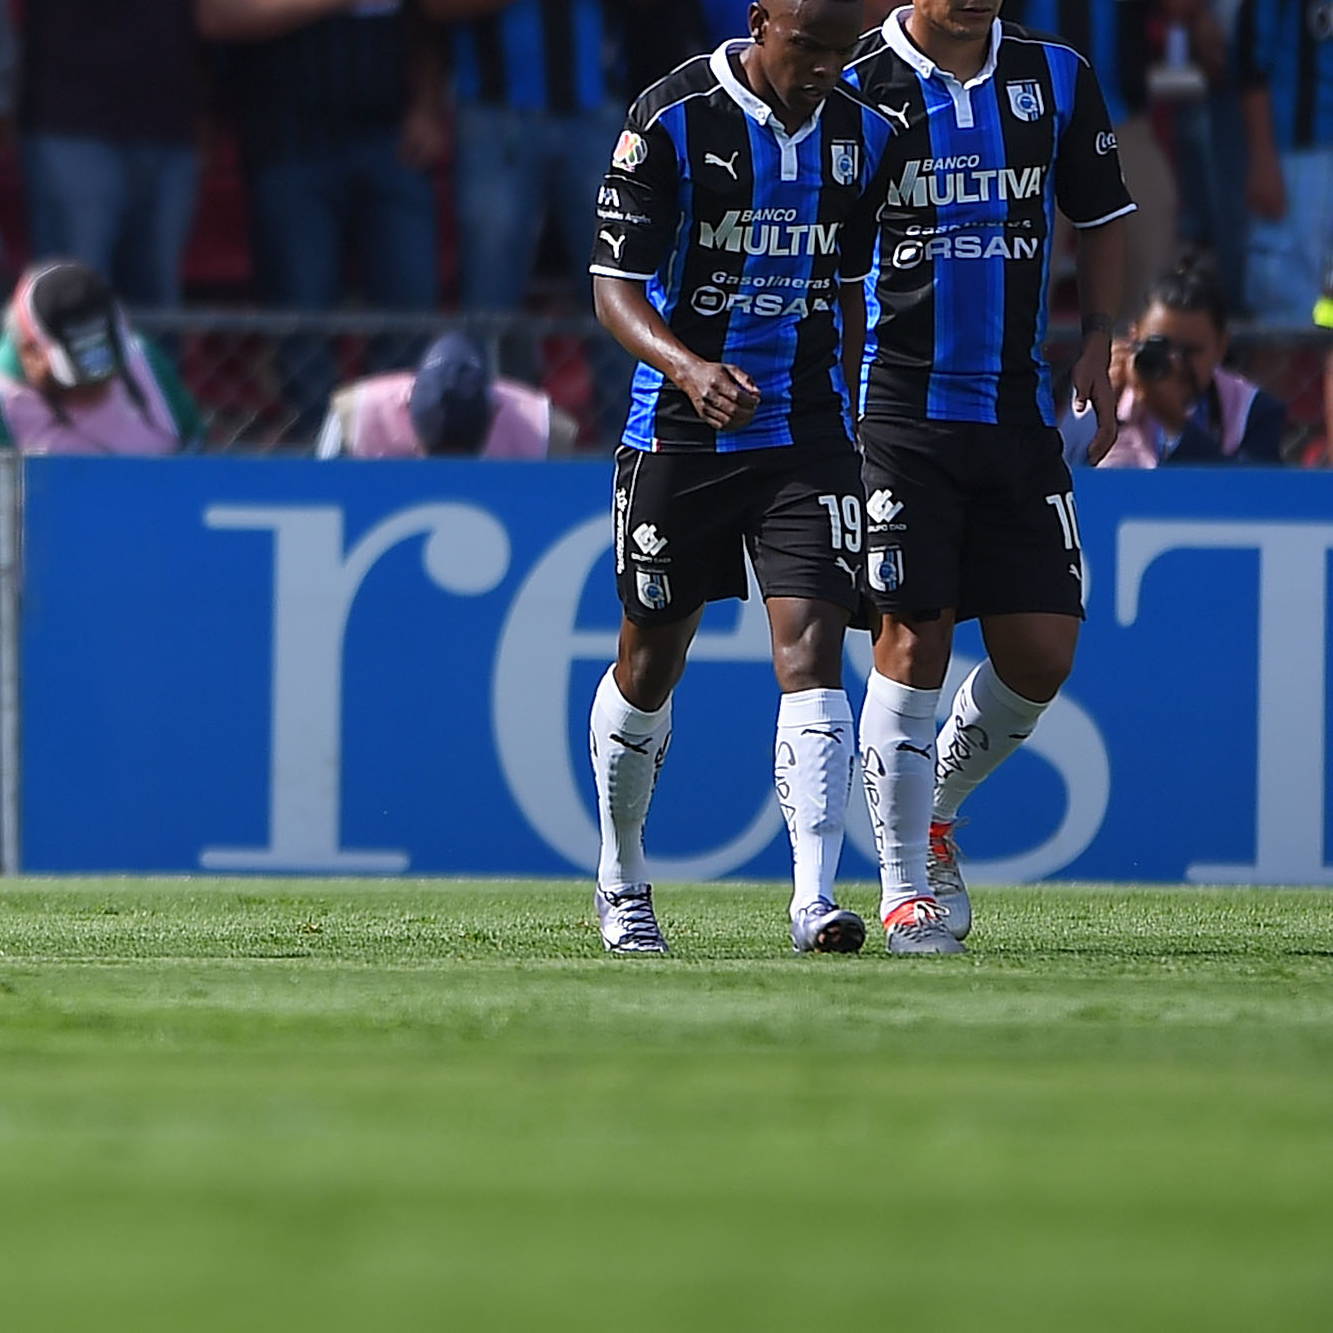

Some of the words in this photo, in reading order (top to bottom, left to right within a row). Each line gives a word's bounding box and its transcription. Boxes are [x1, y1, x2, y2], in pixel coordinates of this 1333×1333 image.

[922, 155, 980, 172] BANCO
[888, 160, 1042, 207] MULTIVA
[741, 209, 797, 222] BANCO
[699, 210, 839, 257] MULTIV
[893, 236, 1038, 270] ORSAN
[712, 271, 830, 289] Gasolineras
[818, 495, 862, 553] 19
